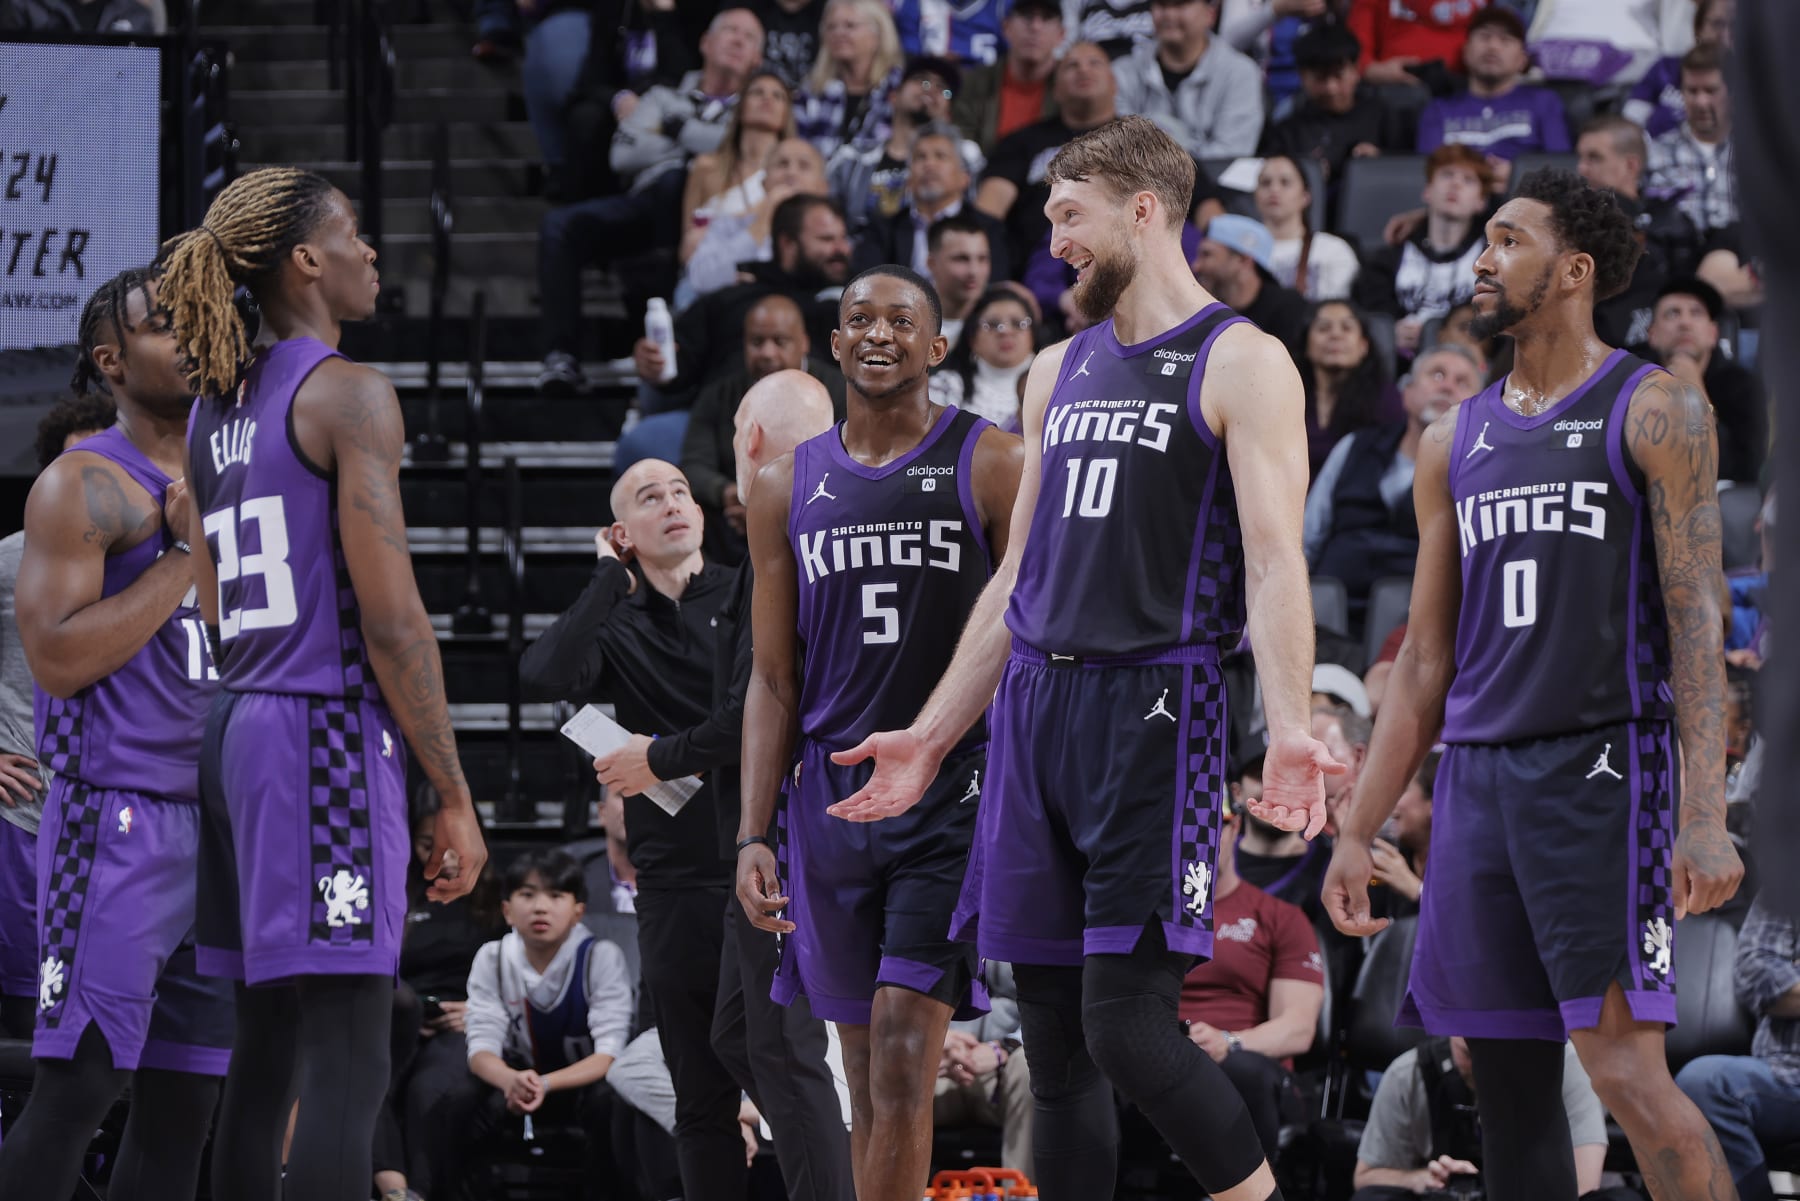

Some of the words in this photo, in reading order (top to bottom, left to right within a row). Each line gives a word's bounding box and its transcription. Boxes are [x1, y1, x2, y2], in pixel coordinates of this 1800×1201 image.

[0, 153, 57, 202] 24
[0, 227, 90, 280] TER
[1153, 348, 1197, 362] dialpad
[1043, 402, 1179, 454] KINGS
[1073, 399, 1146, 410] SACRAMENTO
[1553, 418, 1603, 433] dialpad
[209, 416, 256, 476] ELLIS
[906, 464, 954, 478] dialpad
[1062, 458, 1118, 518] 10
[1478, 482, 1566, 503] SACRAMENTO
[832, 521, 923, 536] SACRAMENTO
[1455, 481, 1608, 557] KINGS
[202, 495, 298, 641] 23
[800, 520, 962, 585] KINGS
[862, 582, 899, 645] 5
[1503, 558, 1537, 628] 0
